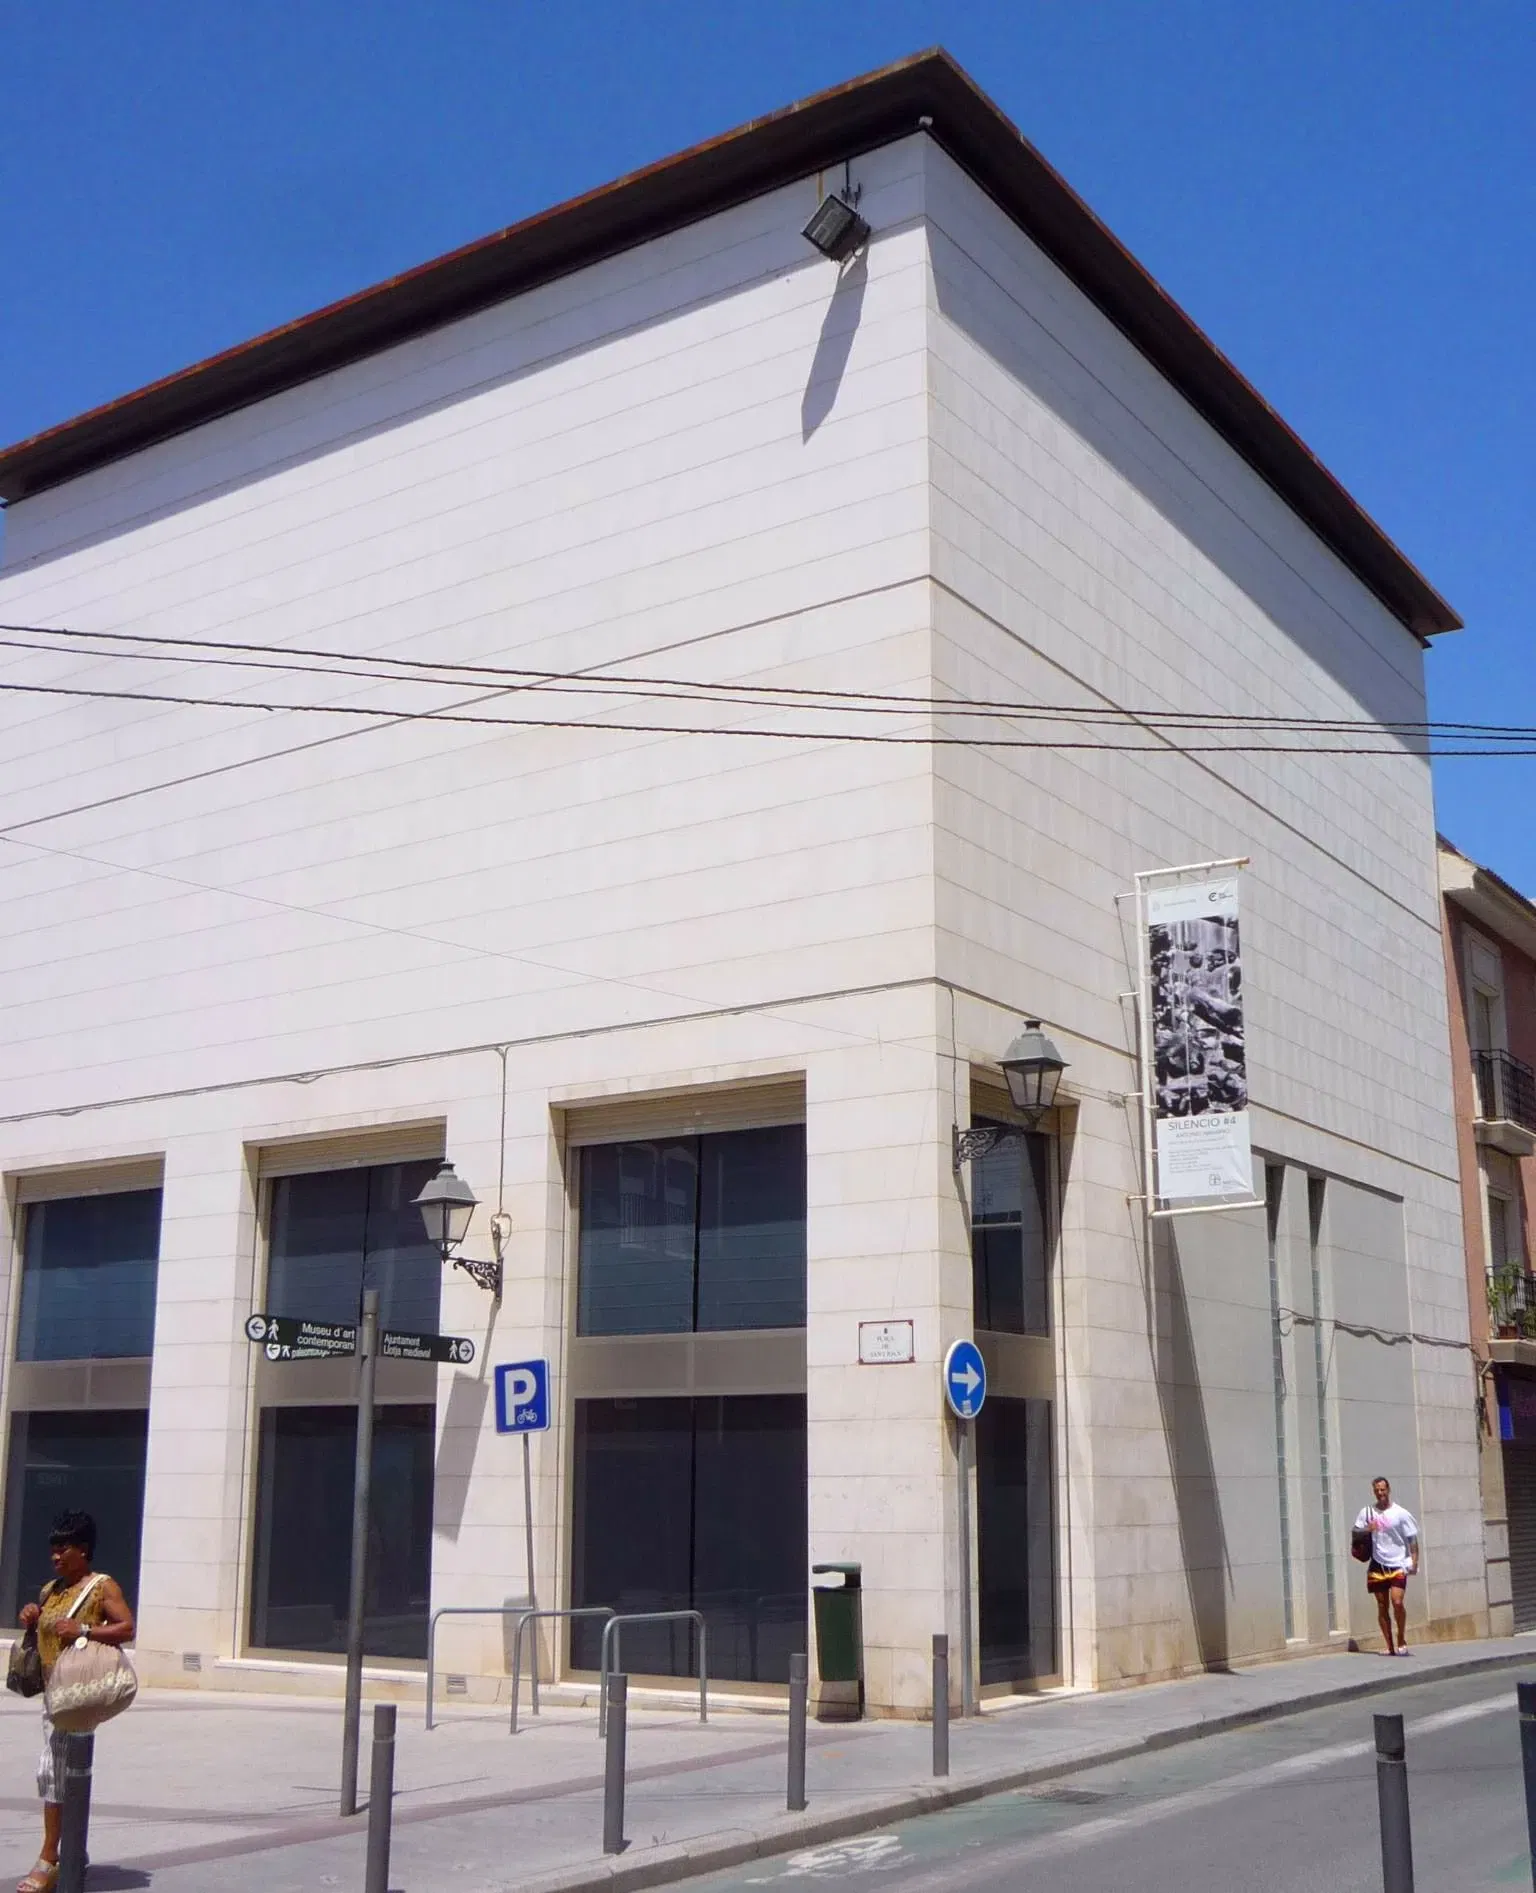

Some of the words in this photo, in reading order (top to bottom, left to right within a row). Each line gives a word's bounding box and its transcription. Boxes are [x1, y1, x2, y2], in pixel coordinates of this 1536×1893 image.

[1168, 1118, 1220, 1130] SILENCIO
[302, 1323, 332, 1336] Museu
[297, 1337, 355, 1350] contemporani
[384, 1333, 420, 1346] Ajuntament
[505, 1369, 537, 1426] P
